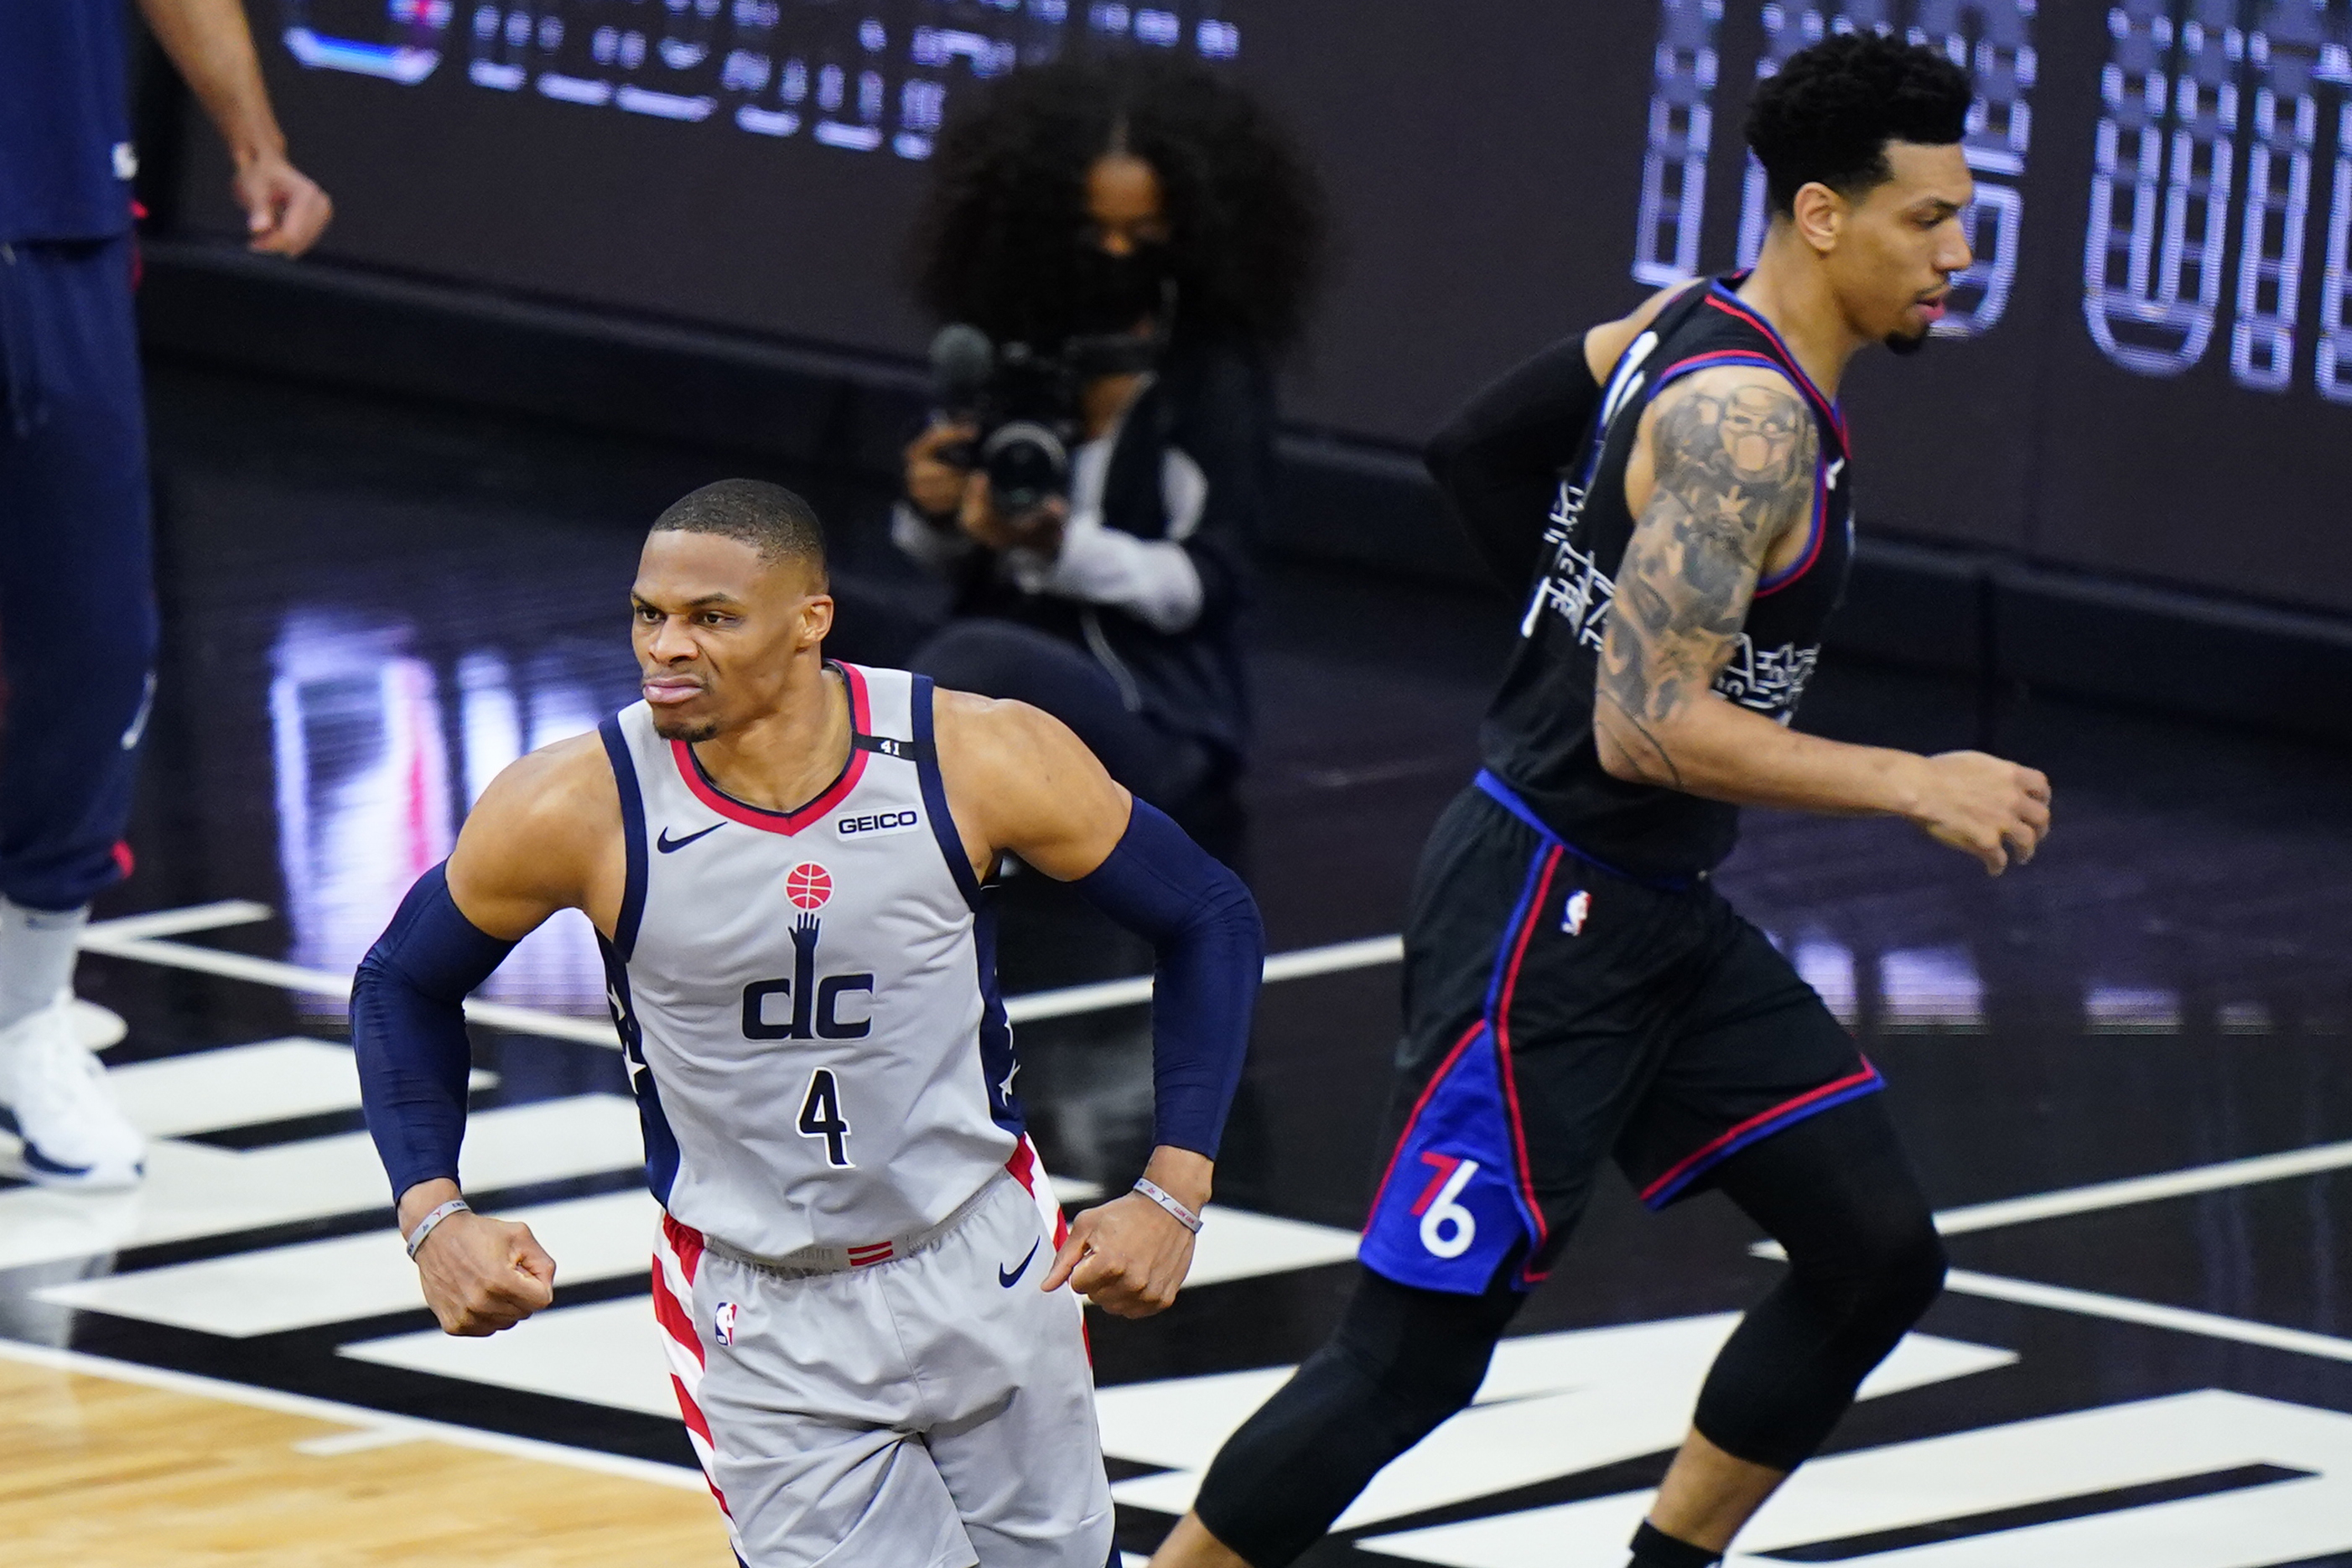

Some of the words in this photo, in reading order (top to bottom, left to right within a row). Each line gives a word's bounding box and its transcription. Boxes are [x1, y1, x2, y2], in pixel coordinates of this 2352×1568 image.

[880, 740, 900, 755] 41
[839, 811, 917, 834] GEICO
[796, 1067, 854, 1168] 4
[1410, 1151, 1479, 1259] 76
